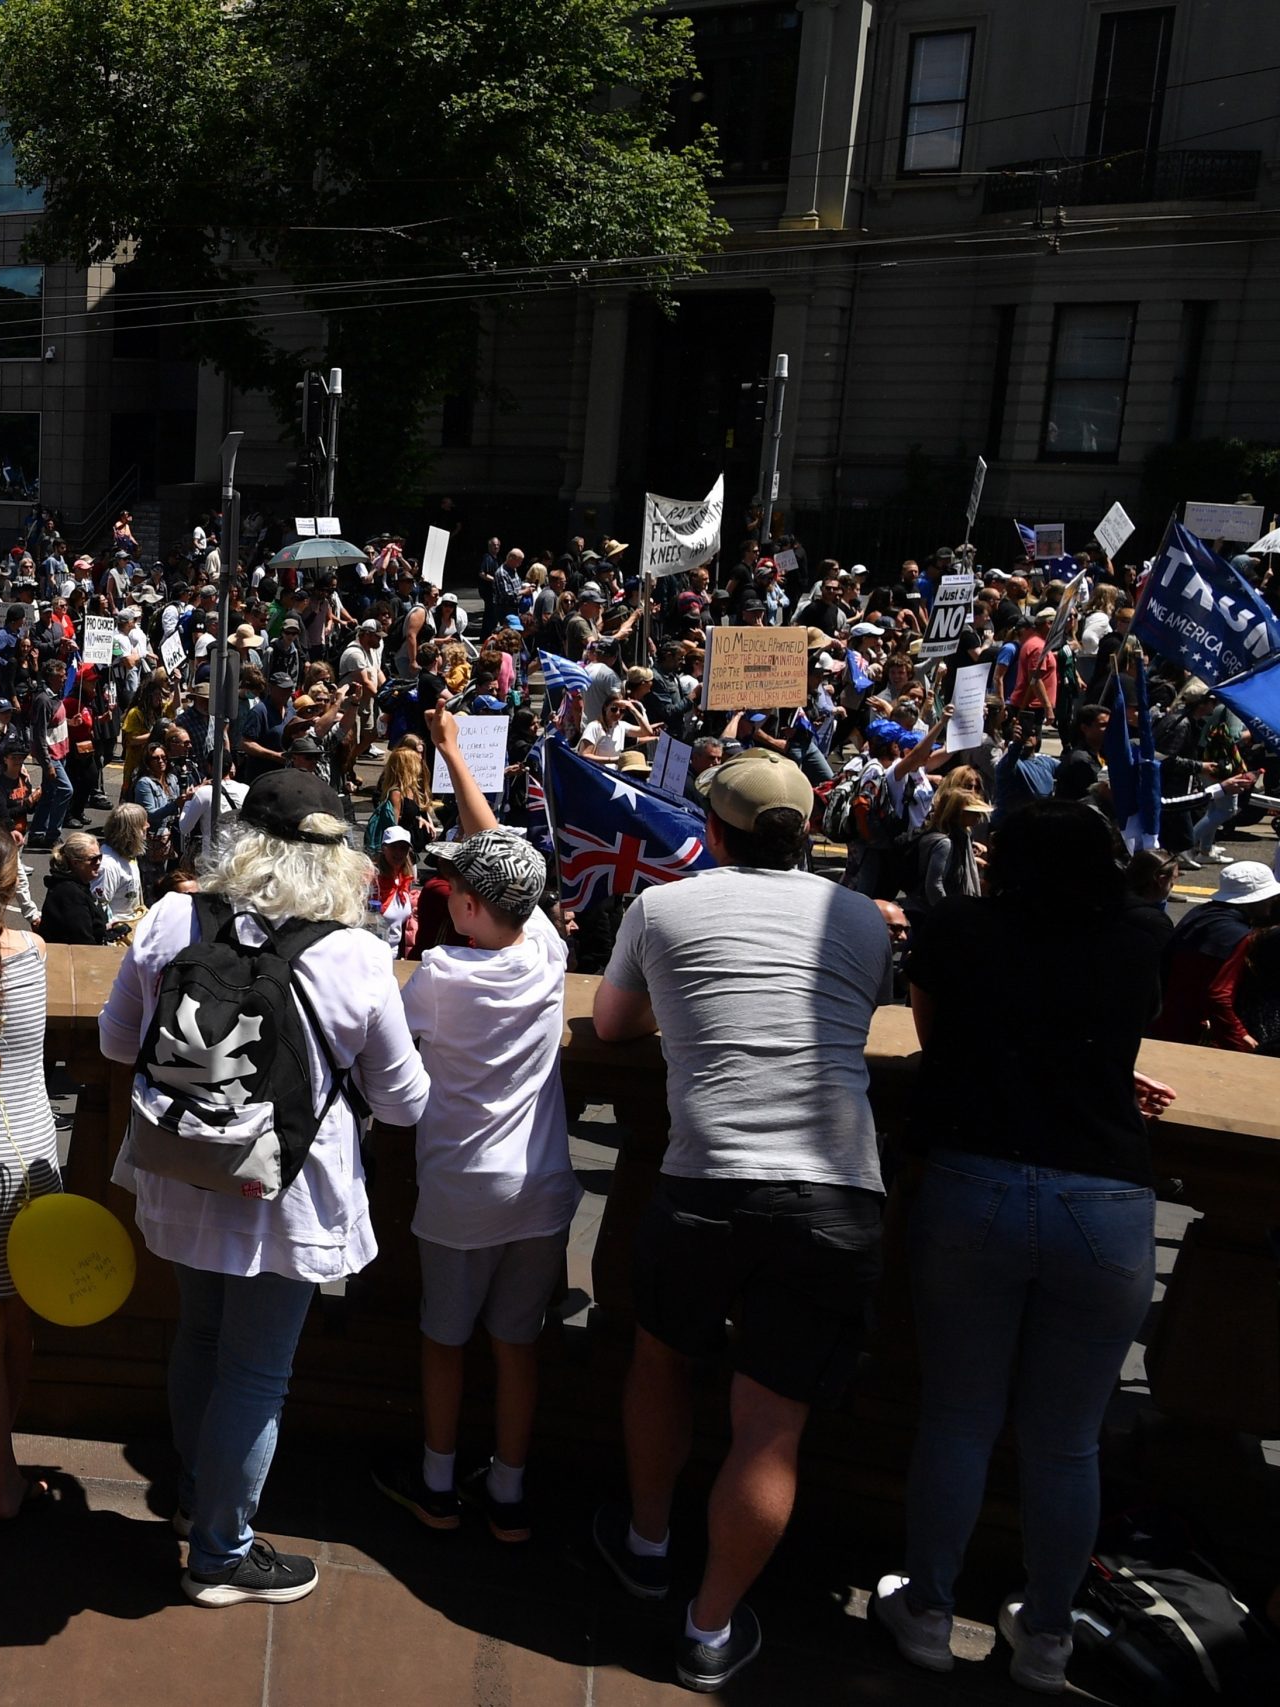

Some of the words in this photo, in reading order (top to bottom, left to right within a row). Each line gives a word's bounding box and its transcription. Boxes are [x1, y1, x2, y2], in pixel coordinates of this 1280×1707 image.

[650, 545, 684, 566] KNEES
[939, 589, 959, 602] Just
[959, 588, 972, 602] Say
[1161, 546, 1270, 659] TRUM
[86, 617, 97, 630] PRO
[97, 618, 113, 631] CHOICE
[929, 605, 966, 639] NO
[1147, 599, 1168, 623] MAKE
[1164, 611, 1222, 657] AMERICA
[715, 636, 731, 654] NO
[732, 632, 767, 653] MEDICAL
[768, 637, 805, 654] APARTHEID
[724, 654, 739, 666] STOP
[740, 654, 752, 665] THE
[754, 655, 805, 667] DISCRIMINATION
[712, 667, 728, 680] STOP
[729, 666, 741, 678] THE
[711, 681, 744, 691] MANDATES
[711, 692, 736, 705] LEAVE
[737, 691, 748, 702] OUR
[749, 690, 780, 702] CHILDREN
[781, 689, 802, 701] ALONE
